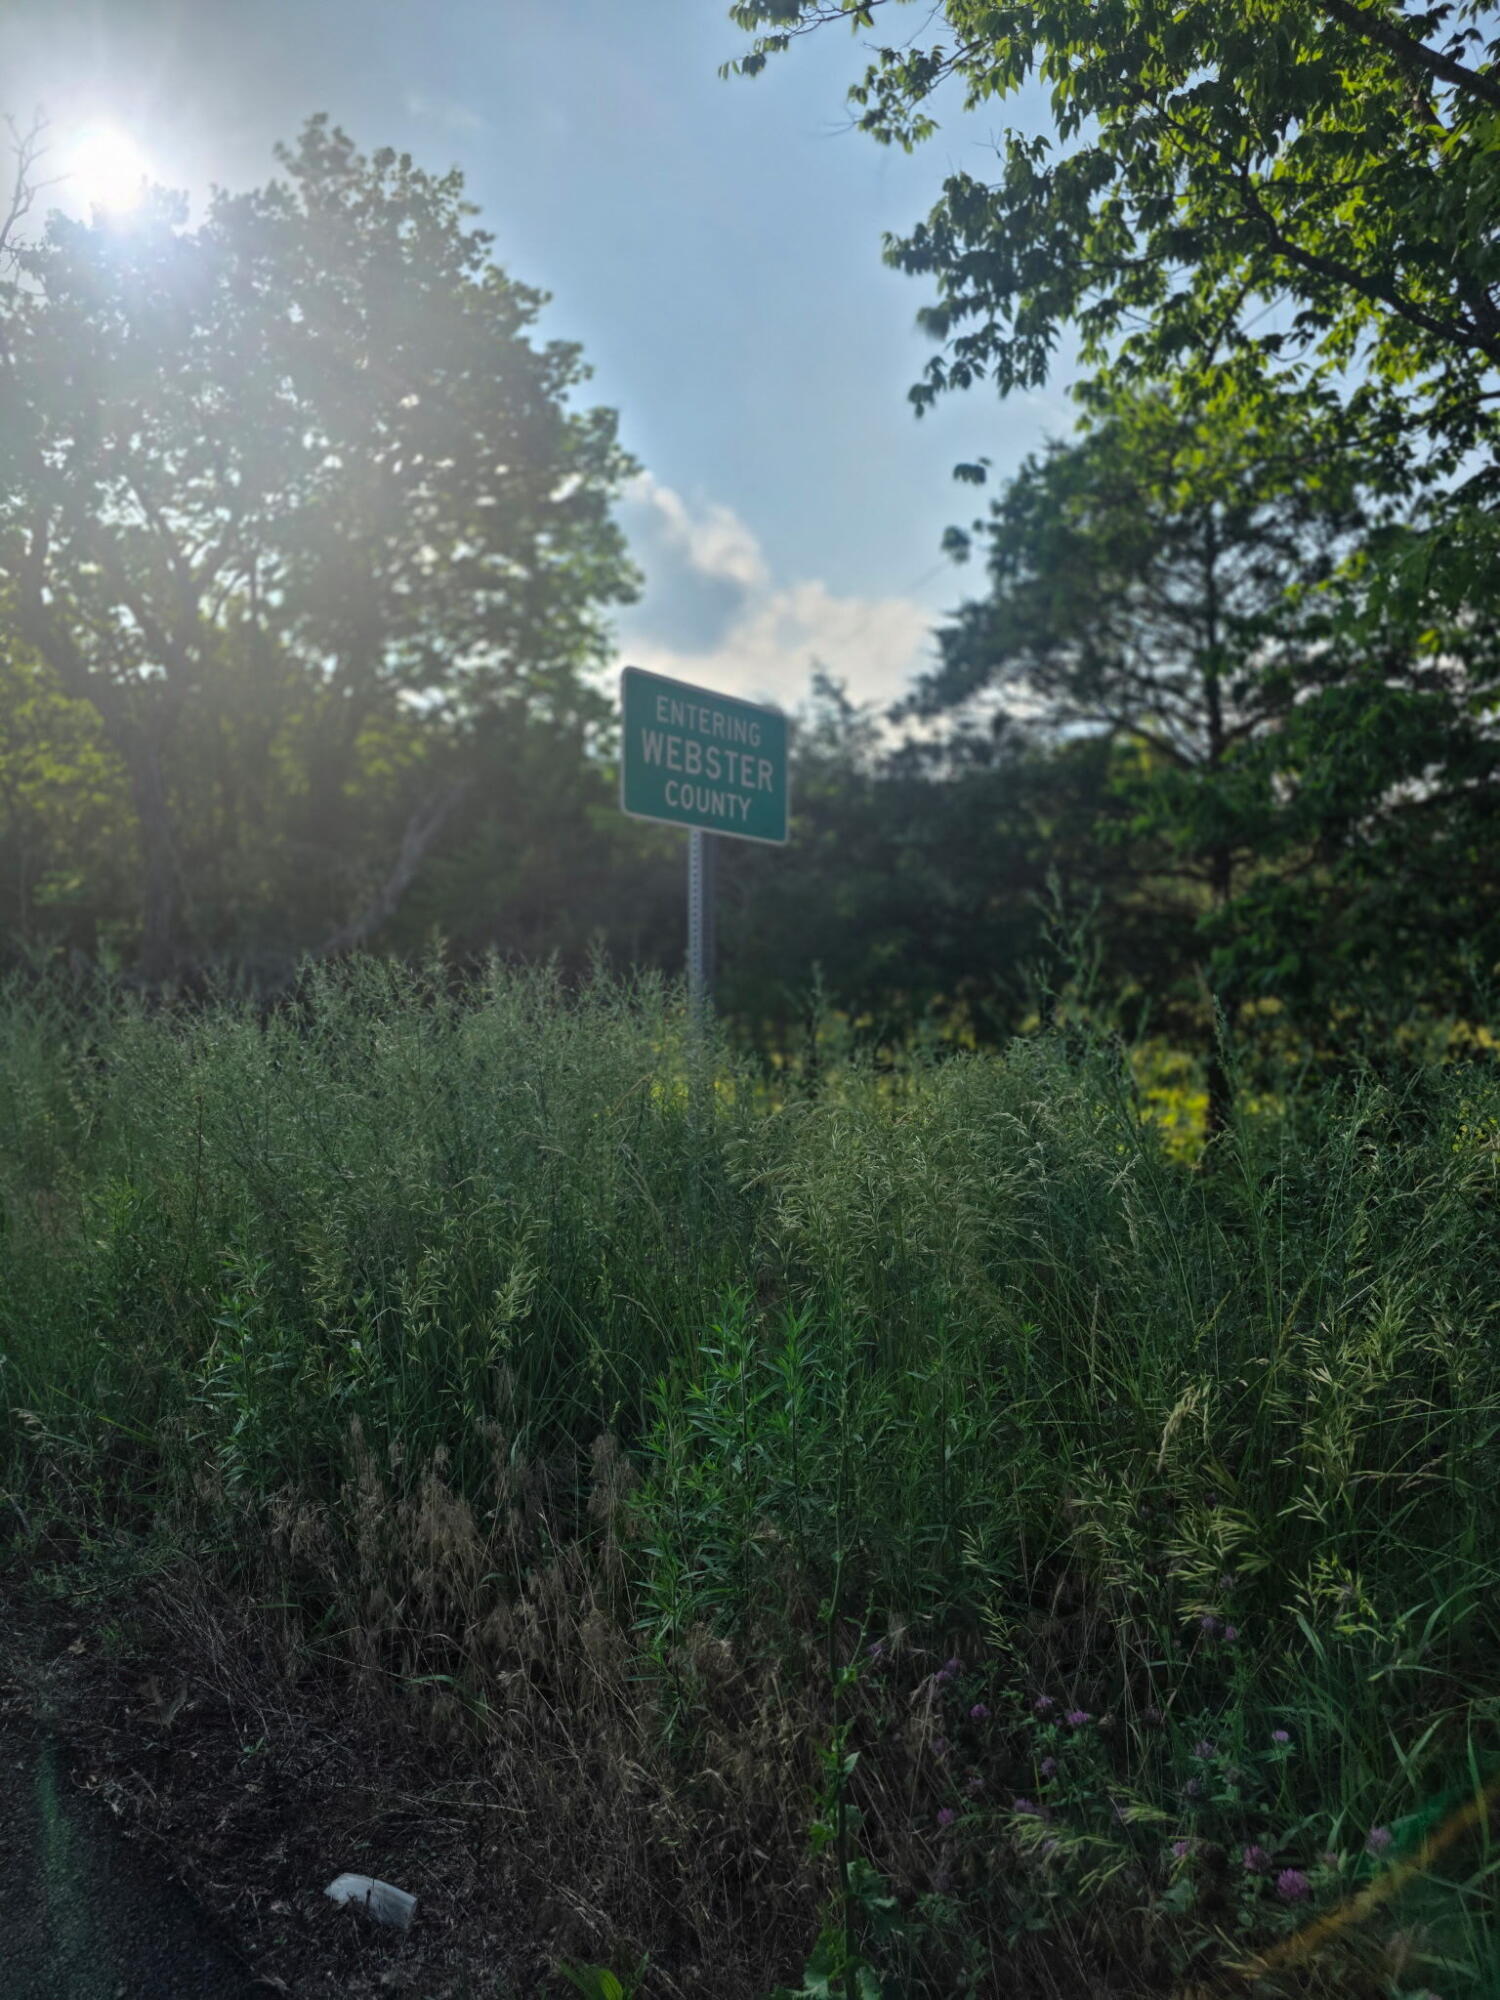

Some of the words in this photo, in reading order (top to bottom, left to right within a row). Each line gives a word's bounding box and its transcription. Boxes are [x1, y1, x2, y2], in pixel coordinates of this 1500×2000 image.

[656, 695, 761, 747] ENTERING
[642, 728, 774, 792] WEBSTER
[665, 780, 752, 821] COUNTY
